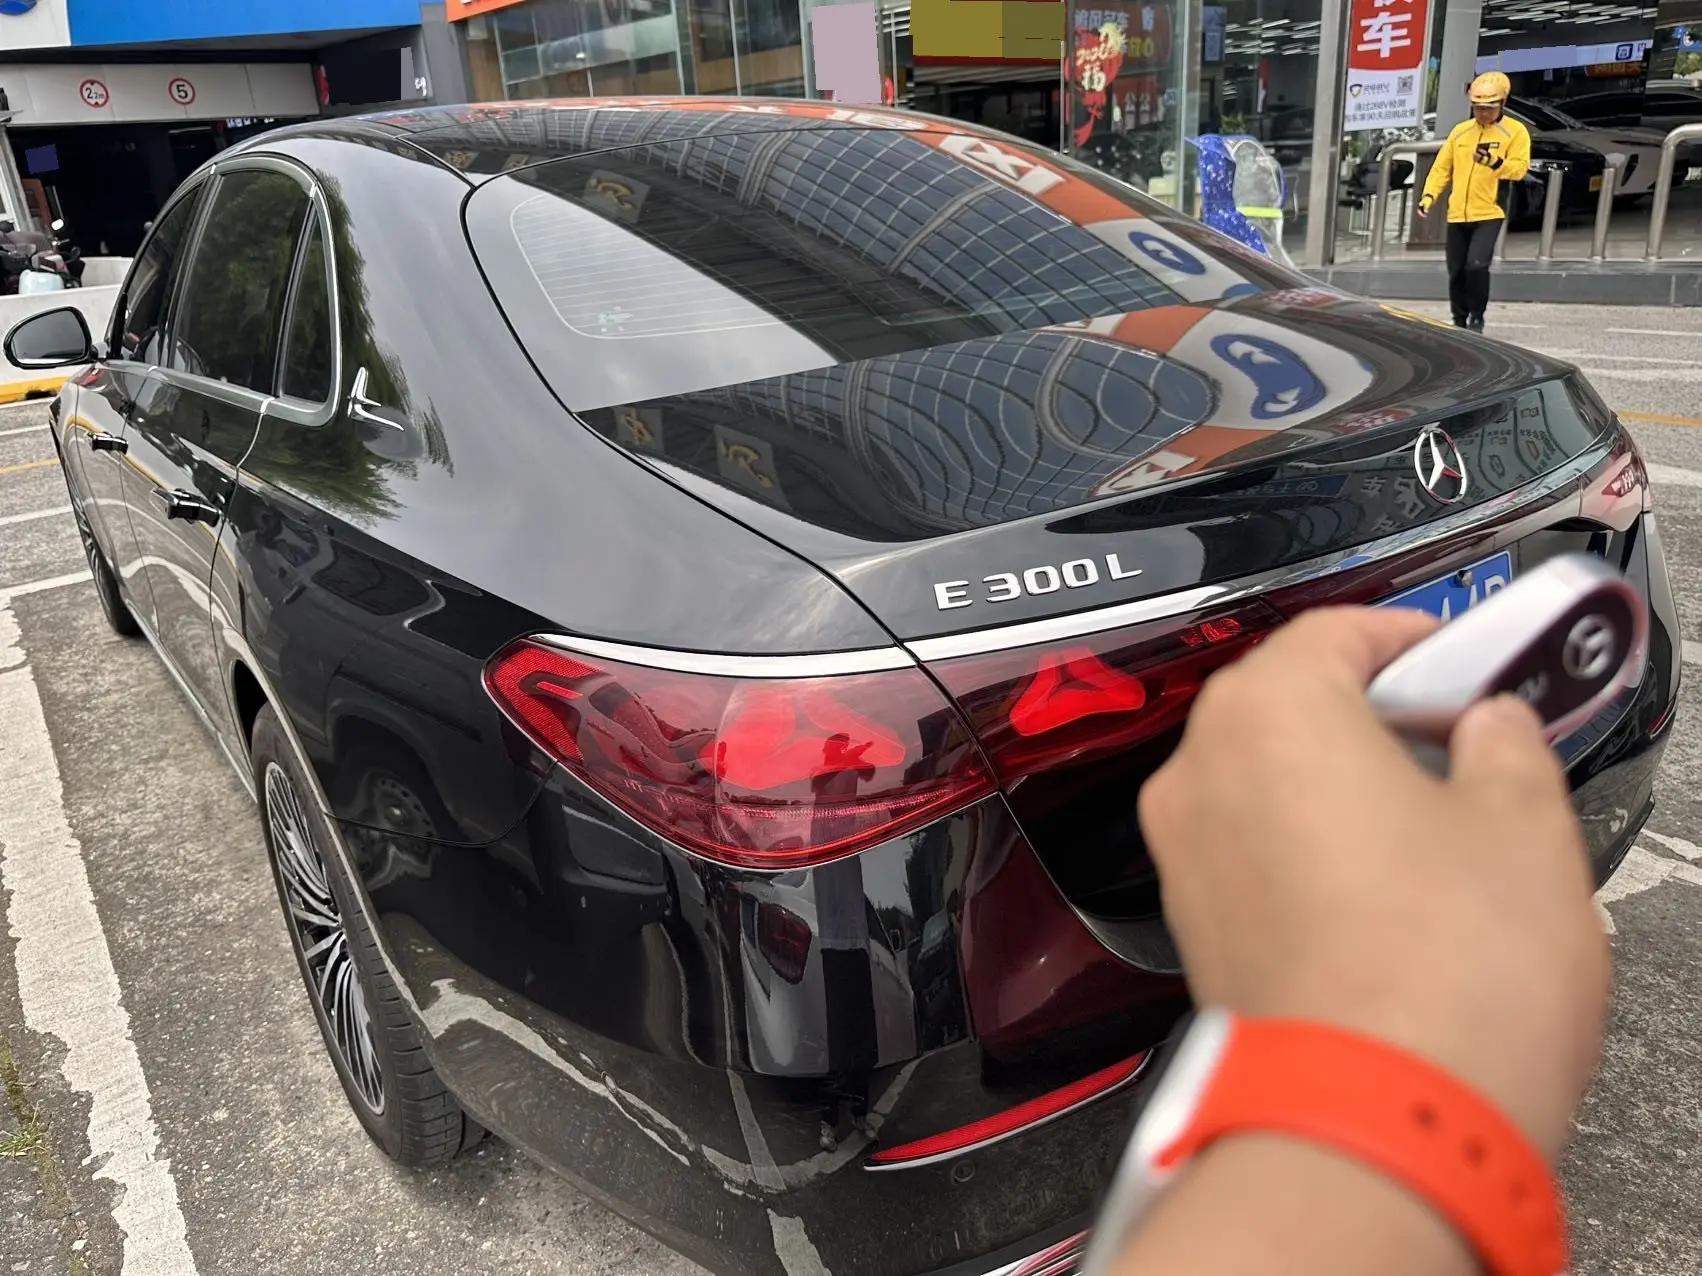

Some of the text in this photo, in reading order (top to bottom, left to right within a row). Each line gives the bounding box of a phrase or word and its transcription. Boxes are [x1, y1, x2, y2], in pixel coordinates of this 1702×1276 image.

[1357, 0, 1412, 58] 车
[175, 83, 188, 100] 5
[934, 553, 1143, 611] E 300 L
